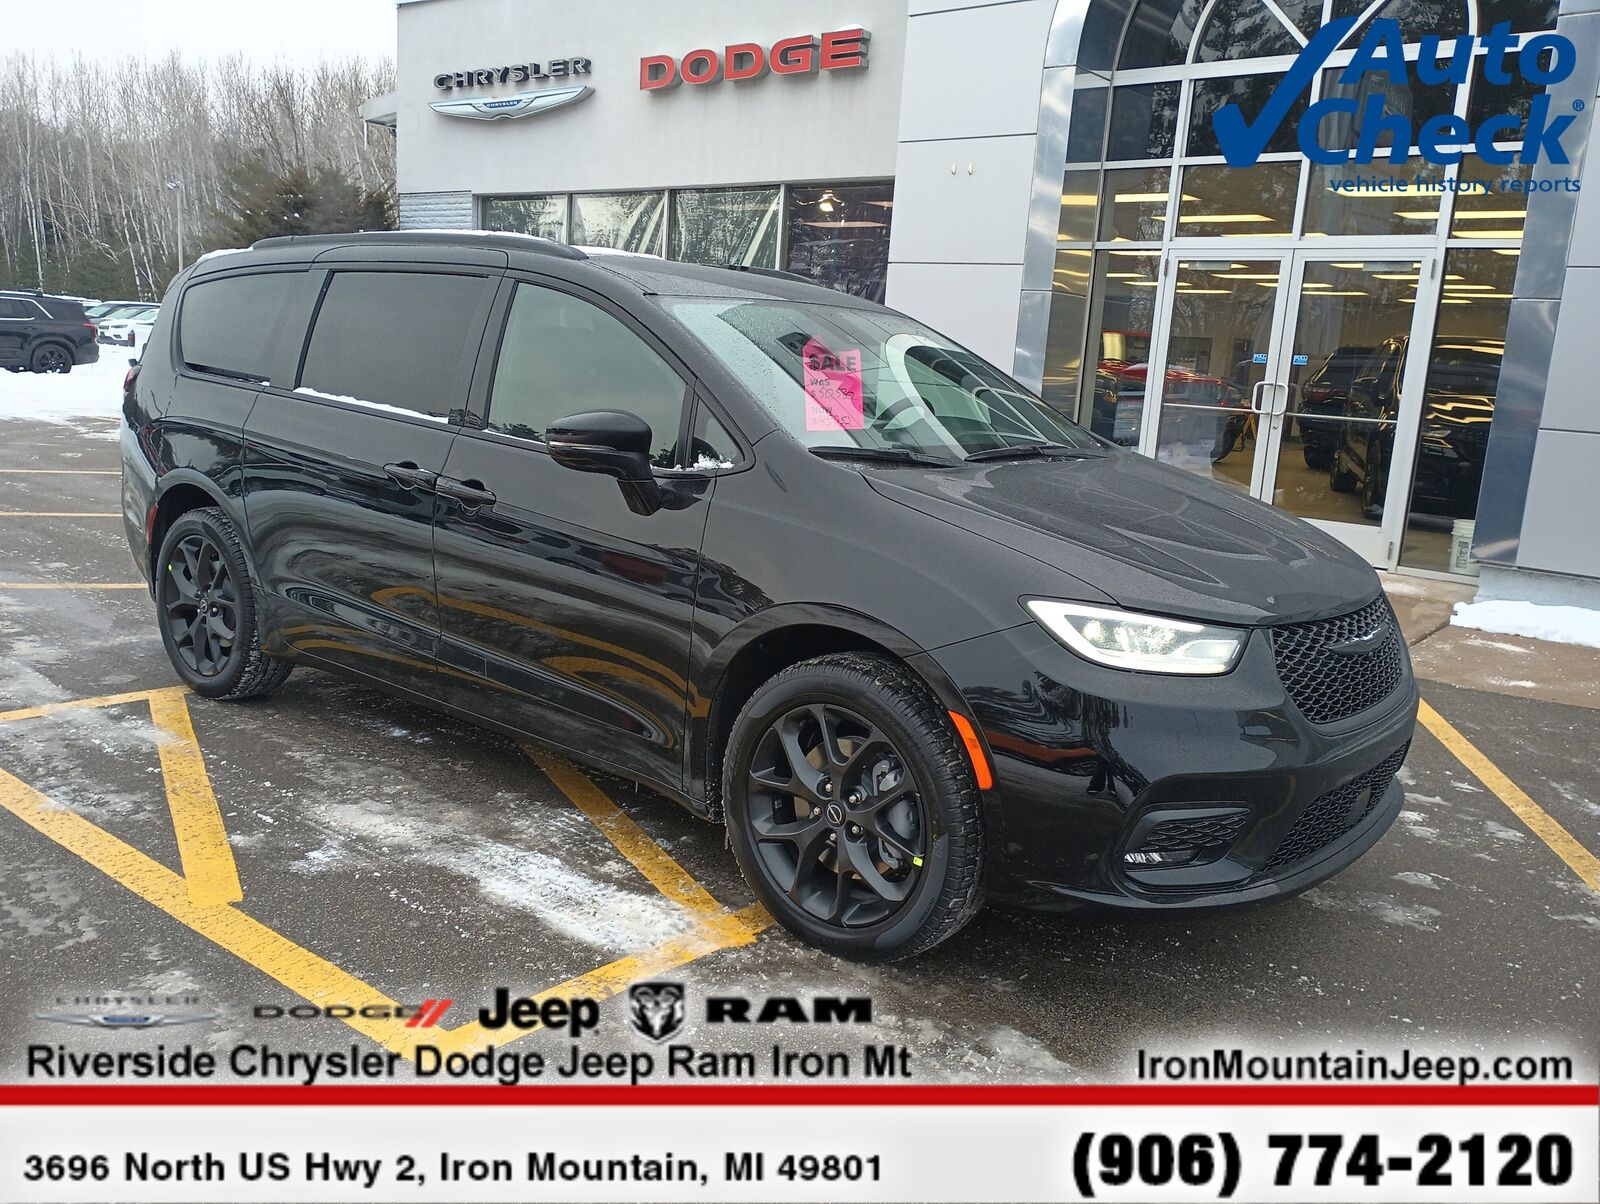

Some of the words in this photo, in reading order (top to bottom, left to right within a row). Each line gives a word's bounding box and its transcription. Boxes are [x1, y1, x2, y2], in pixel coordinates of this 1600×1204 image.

[434, 56, 592, 90] CHRYSLER
[640, 28, 870, 91] DODGE
[809, 353, 857, 372] SALE
